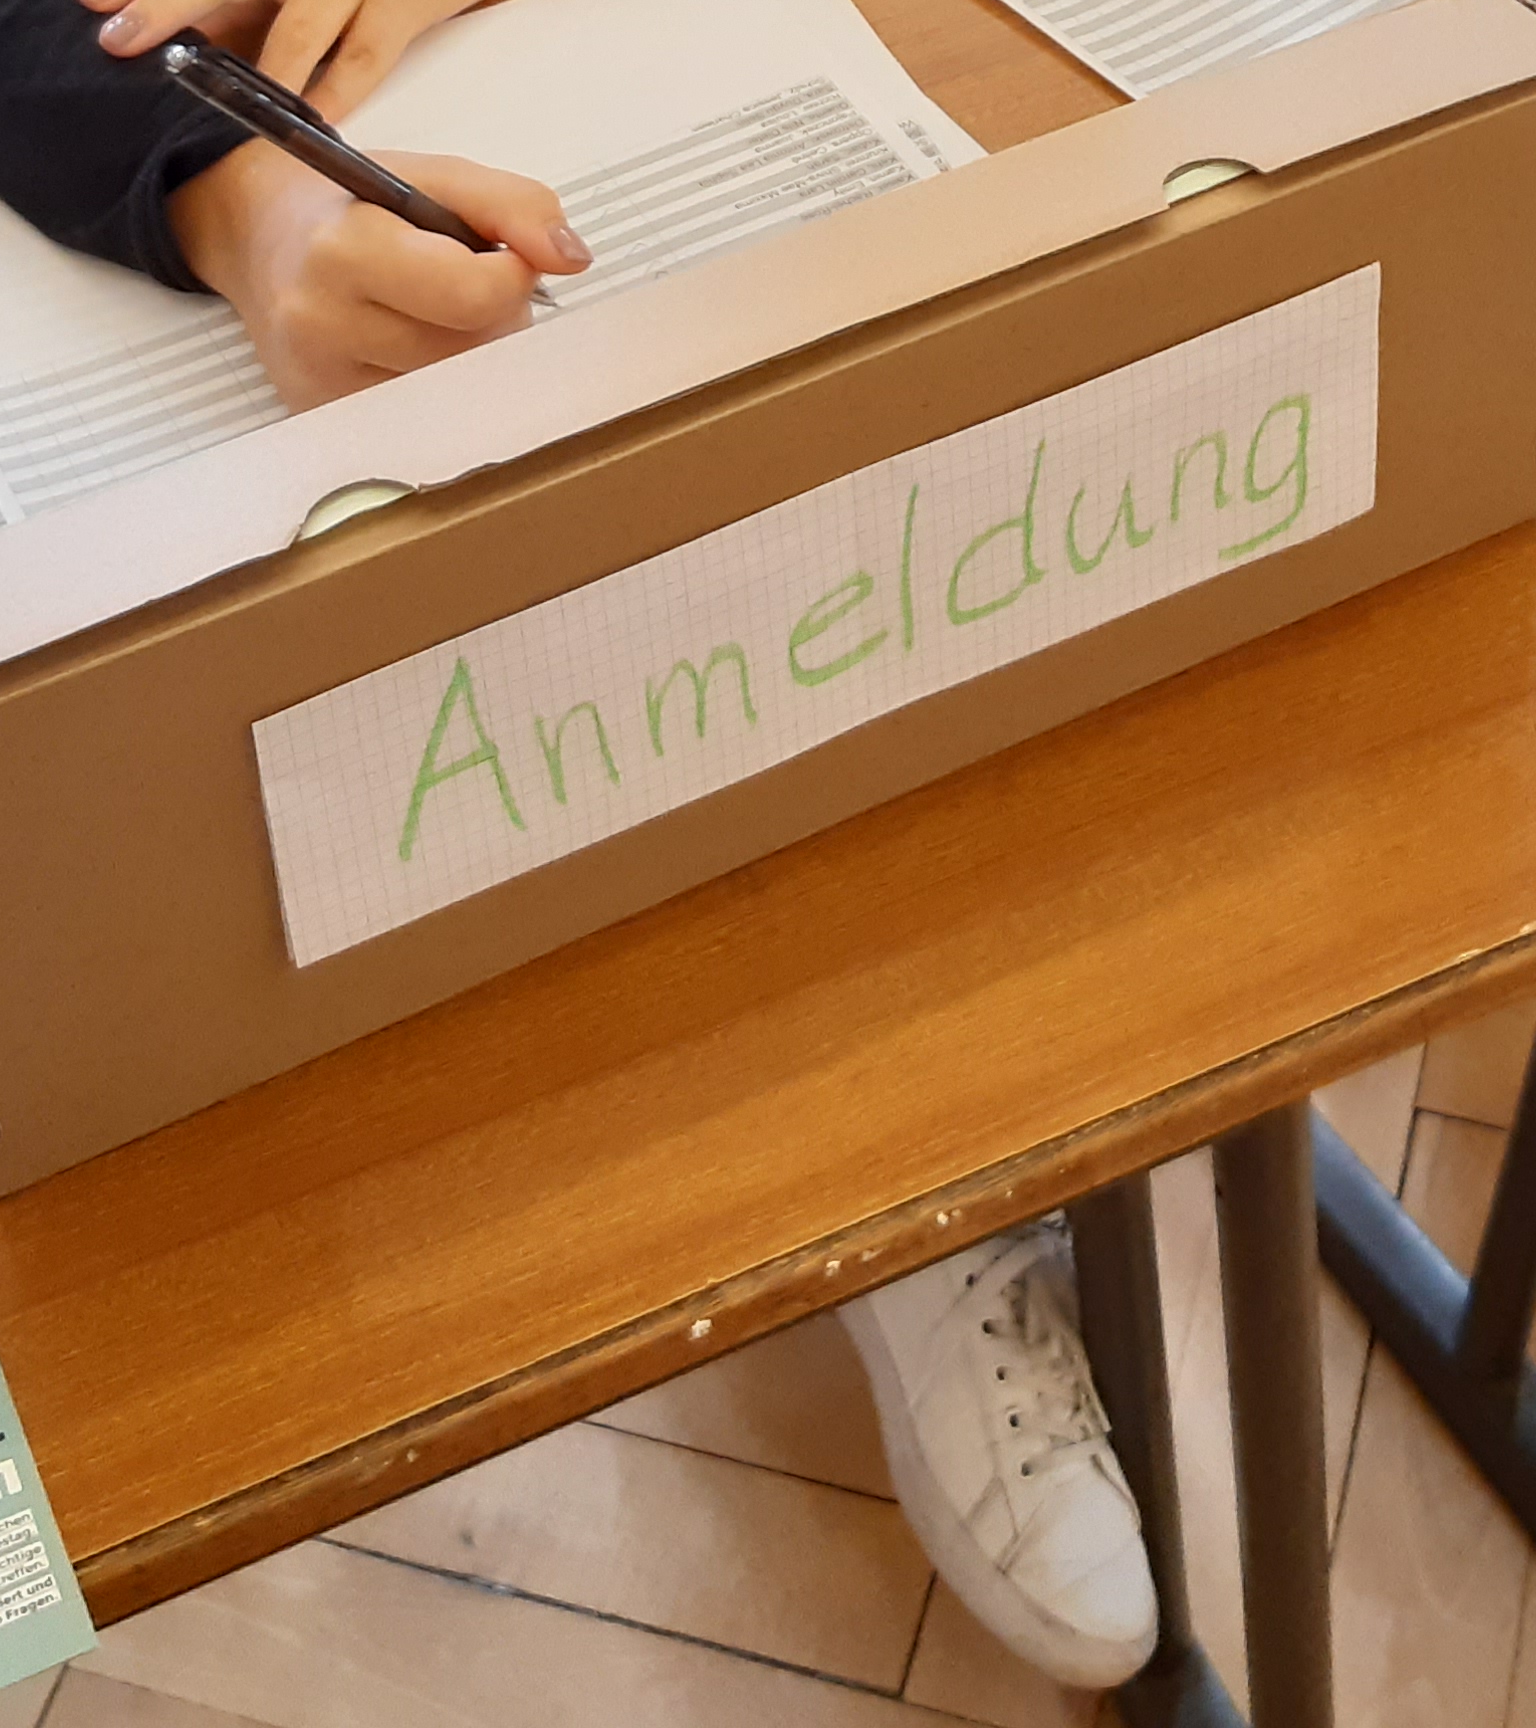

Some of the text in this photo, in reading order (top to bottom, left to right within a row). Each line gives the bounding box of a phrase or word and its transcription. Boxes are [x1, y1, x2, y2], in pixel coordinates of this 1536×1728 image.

[400, 393, 1313, 861] Anmeldung
[24, 1576, 54, 1597] und
[5, 1592, 56, 1621] Fragen.
